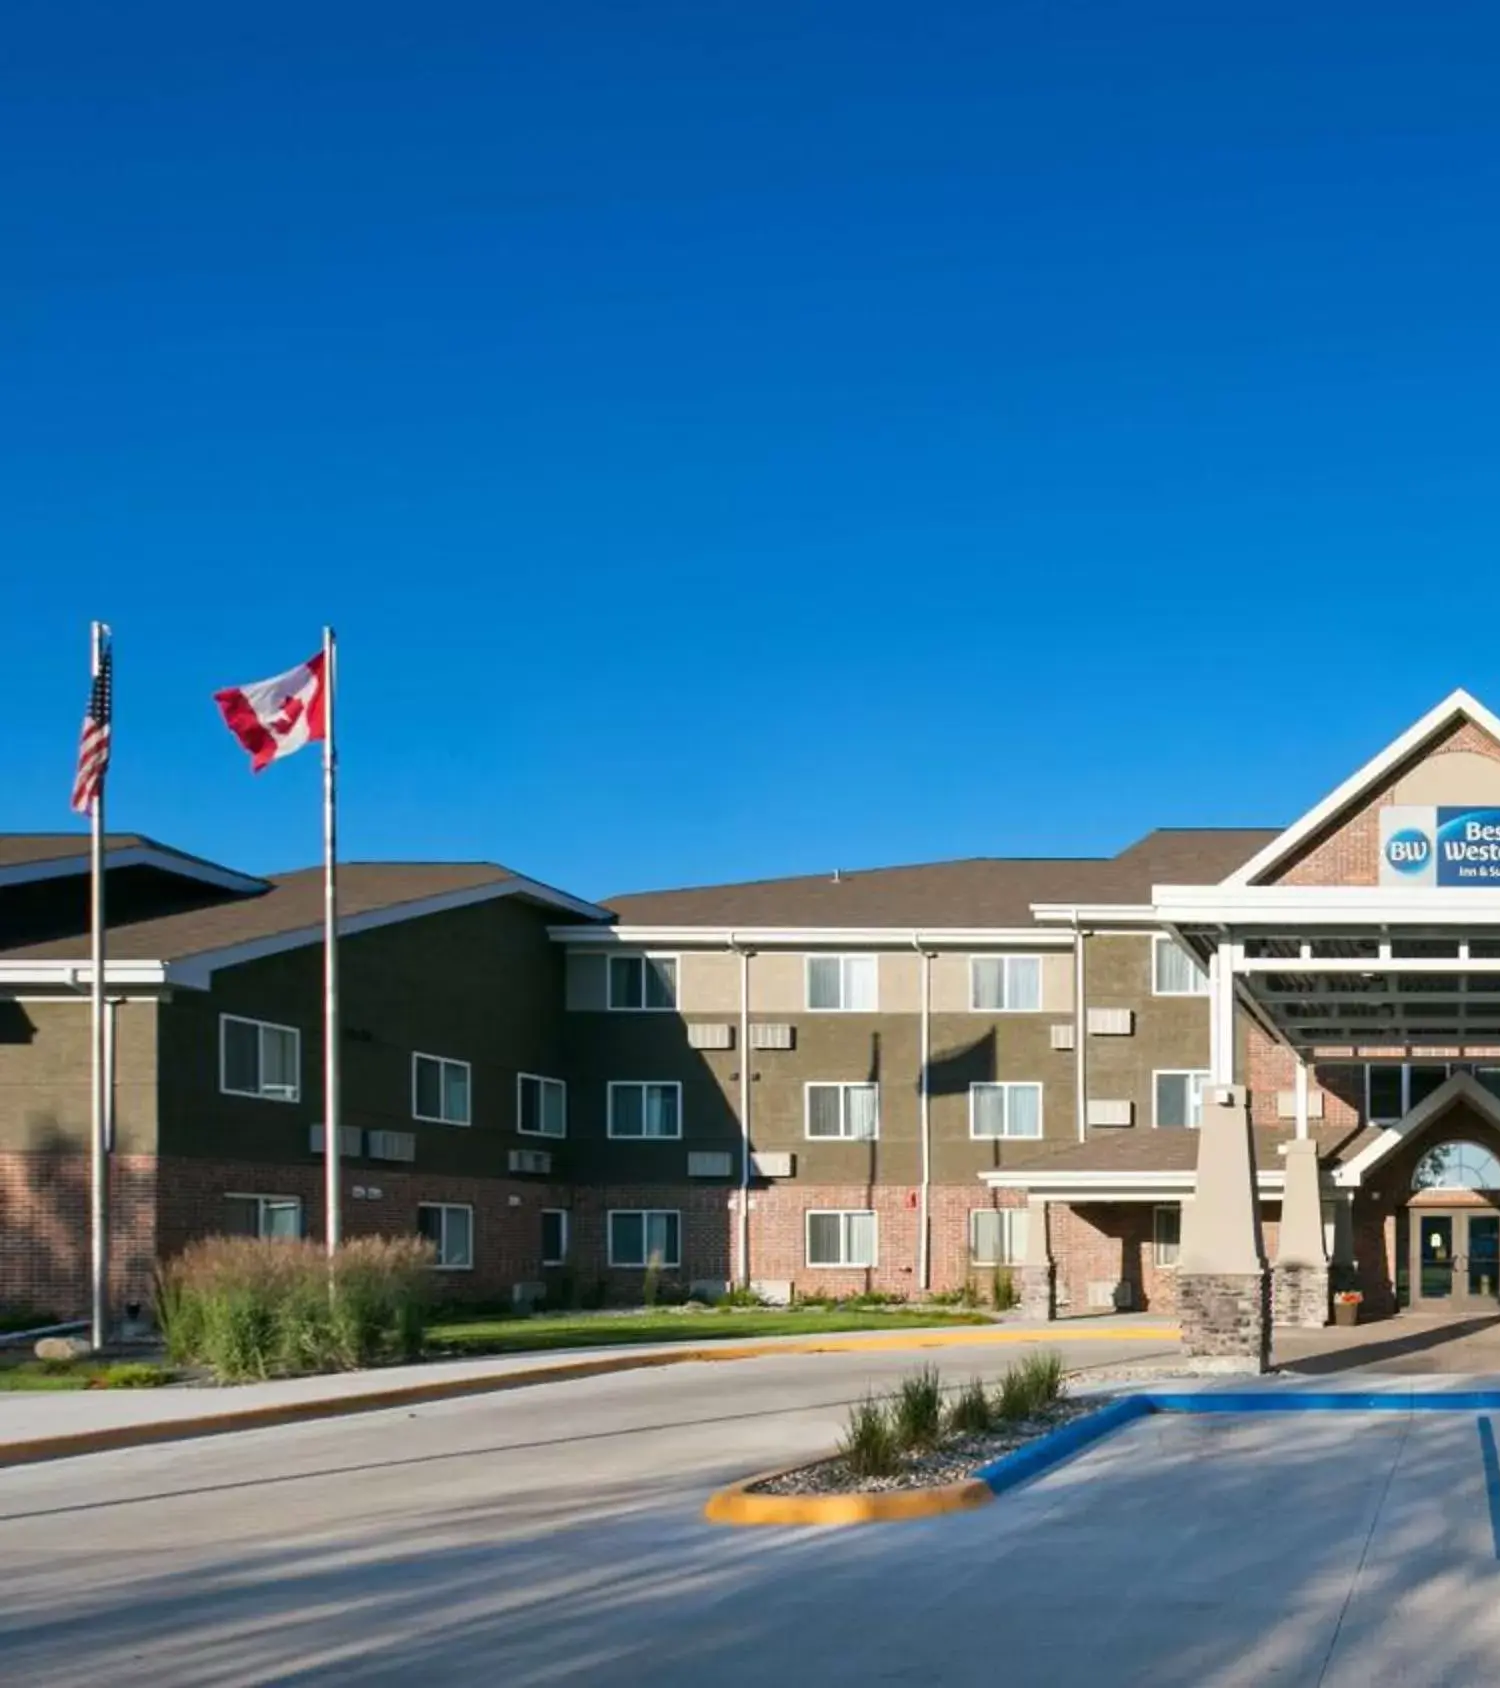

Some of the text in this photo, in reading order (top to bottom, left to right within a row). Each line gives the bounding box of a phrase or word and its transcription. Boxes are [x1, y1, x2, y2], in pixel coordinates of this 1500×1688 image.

[1391, 842, 1427, 861] BW
[1459, 866, 1477, 877] Inn
[1479, 866, 1488, 877] &
